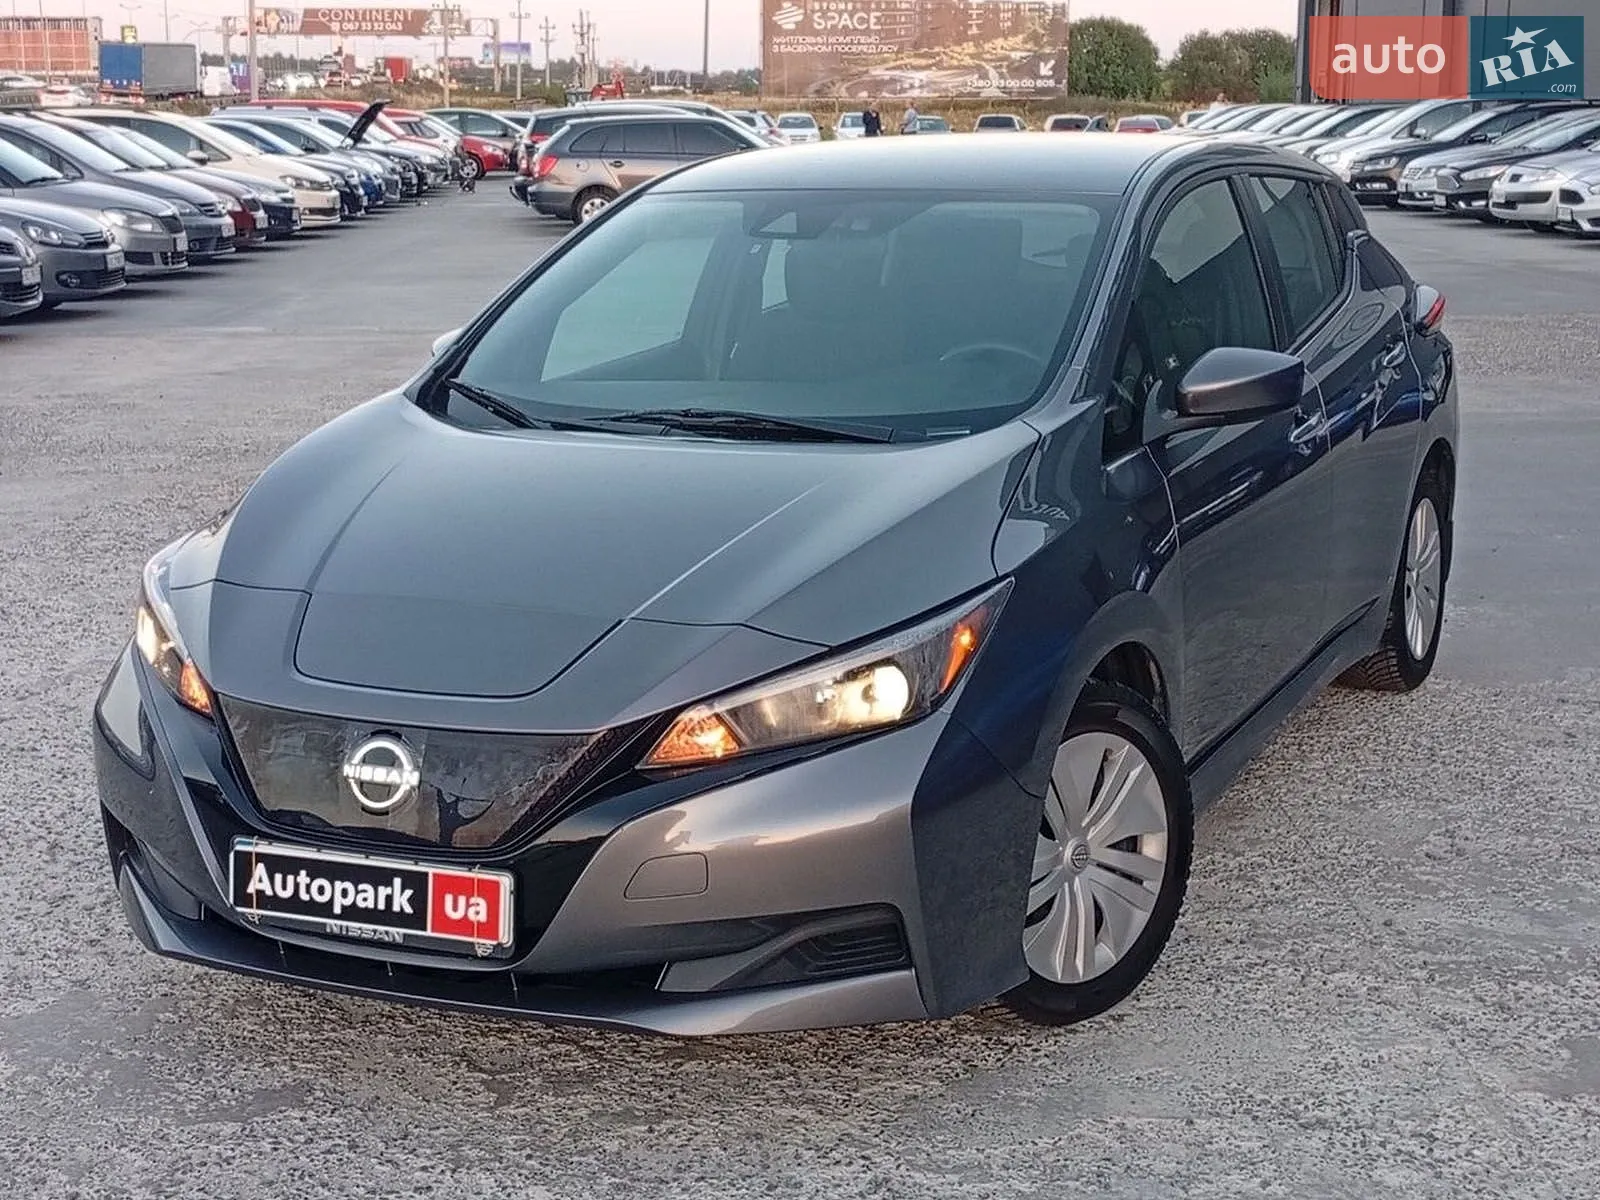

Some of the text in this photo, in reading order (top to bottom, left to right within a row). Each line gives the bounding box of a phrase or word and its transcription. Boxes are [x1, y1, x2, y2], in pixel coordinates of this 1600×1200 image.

[318, 8, 413, 21] CONTINENT
[813, 12, 882, 29] SPACE
[343, 763, 420, 786] NISSAN
[246, 862, 489, 923] Autopark ua
[325, 922, 405, 944] NISSAN
